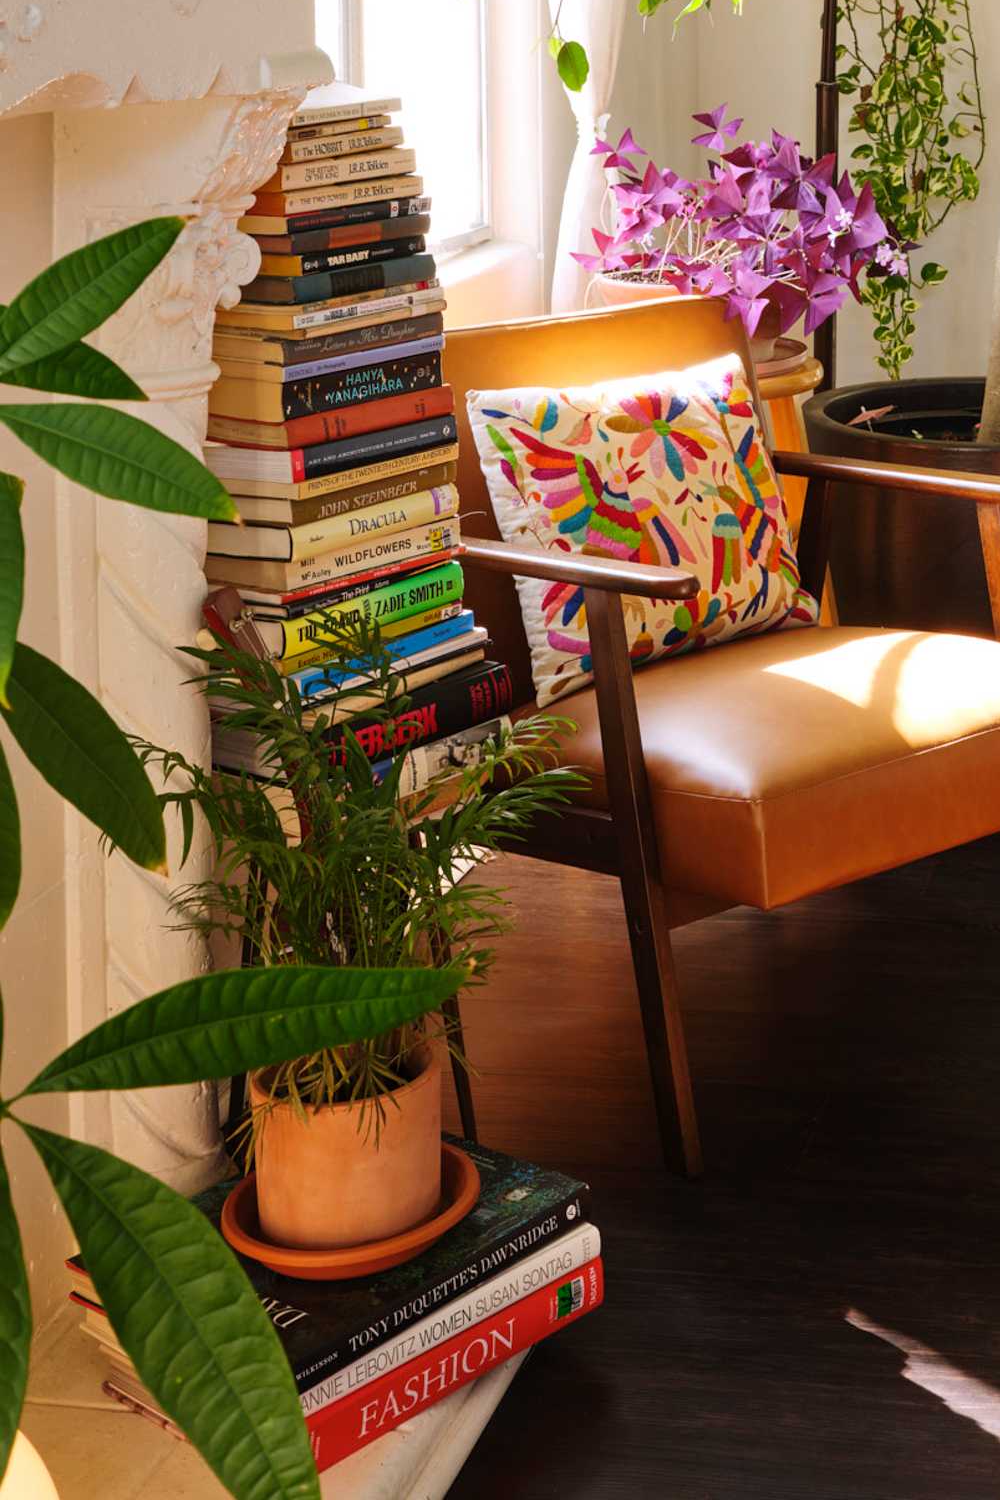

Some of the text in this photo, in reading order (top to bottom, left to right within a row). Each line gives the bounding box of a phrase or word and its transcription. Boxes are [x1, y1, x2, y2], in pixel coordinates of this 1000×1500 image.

[314, 141, 343, 156] HOBBIT
[328, 254, 346, 266] TAR
[346, 250, 370, 264] BABY
[328, 378, 404, 404] YANAGIHARA
[346, 368, 384, 386] HANYA
[318, 504, 350, 519] JOHN
[352, 481, 417, 510] STEINBECK
[349, 510, 407, 537] DRACULA
[334, 538, 412, 568] WILDFLOWERS
[374, 594, 406, 618] ZADIE
[409, 580, 444, 606] SMITH
[349, 1315, 390, 1351] TONY
[394, 1264, 478, 1326] DUQUETTE'S
[480, 1216, 558, 1274] DAWNRIDGE
[302, 1252, 572, 1411] ANNIE LEIBOVITZ WOMEN SUSAN SONTAG
[296, 1351, 338, 1380] WILKINSON
[358, 1318, 516, 1438] FASHION
